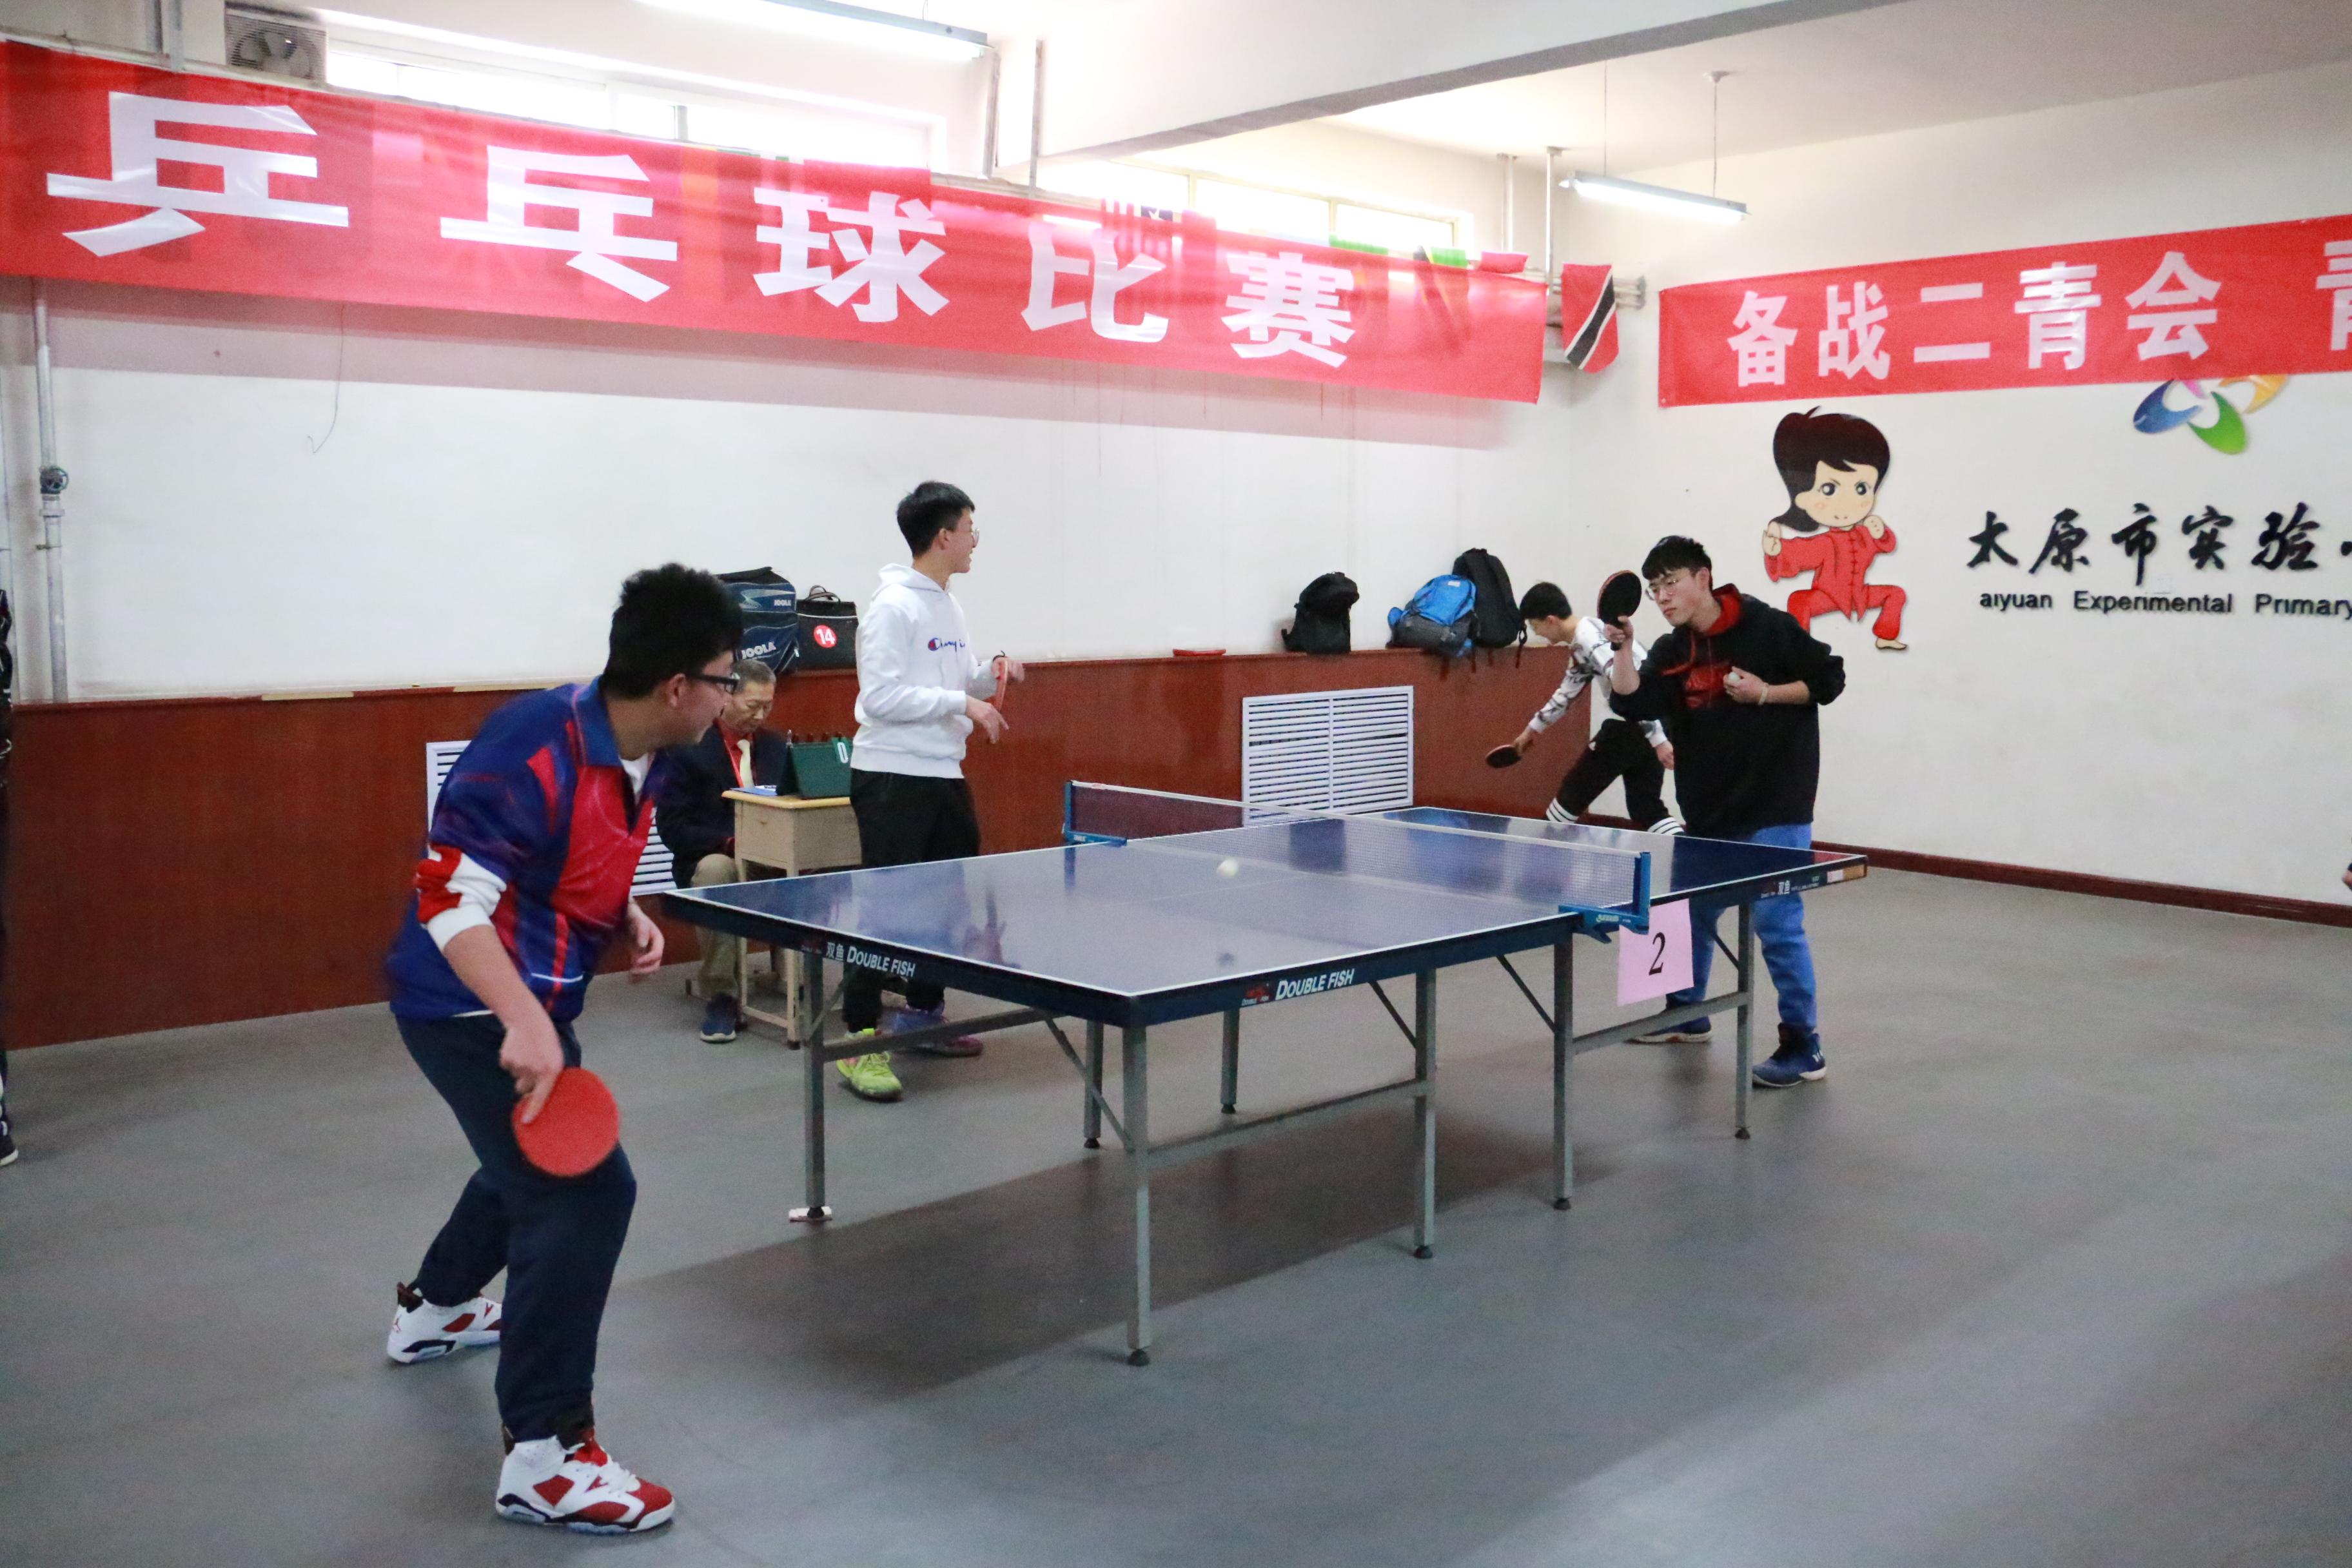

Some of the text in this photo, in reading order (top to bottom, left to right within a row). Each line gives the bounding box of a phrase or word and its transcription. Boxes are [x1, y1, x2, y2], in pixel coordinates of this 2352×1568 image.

[46, 91, 1356, 368] 乒乓球比赛
[1727, 251, 2222, 387] 备战二青会
[1967, 502, 2352, 585] 太原市实验
[2073, 590, 2233, 615] Experimental
[741, 641, 777, 660] JOOLA
[816, 629, 836, 645] 14
[837, 742, 849, 764] 0
[825, 941, 845, 961] 双鱼
[847, 946, 890, 972] DOUBLE
[890, 959, 916, 977] FISH
[1649, 932, 1666, 976] 2
[1275, 968, 1355, 1001] DOUBLE FISH
